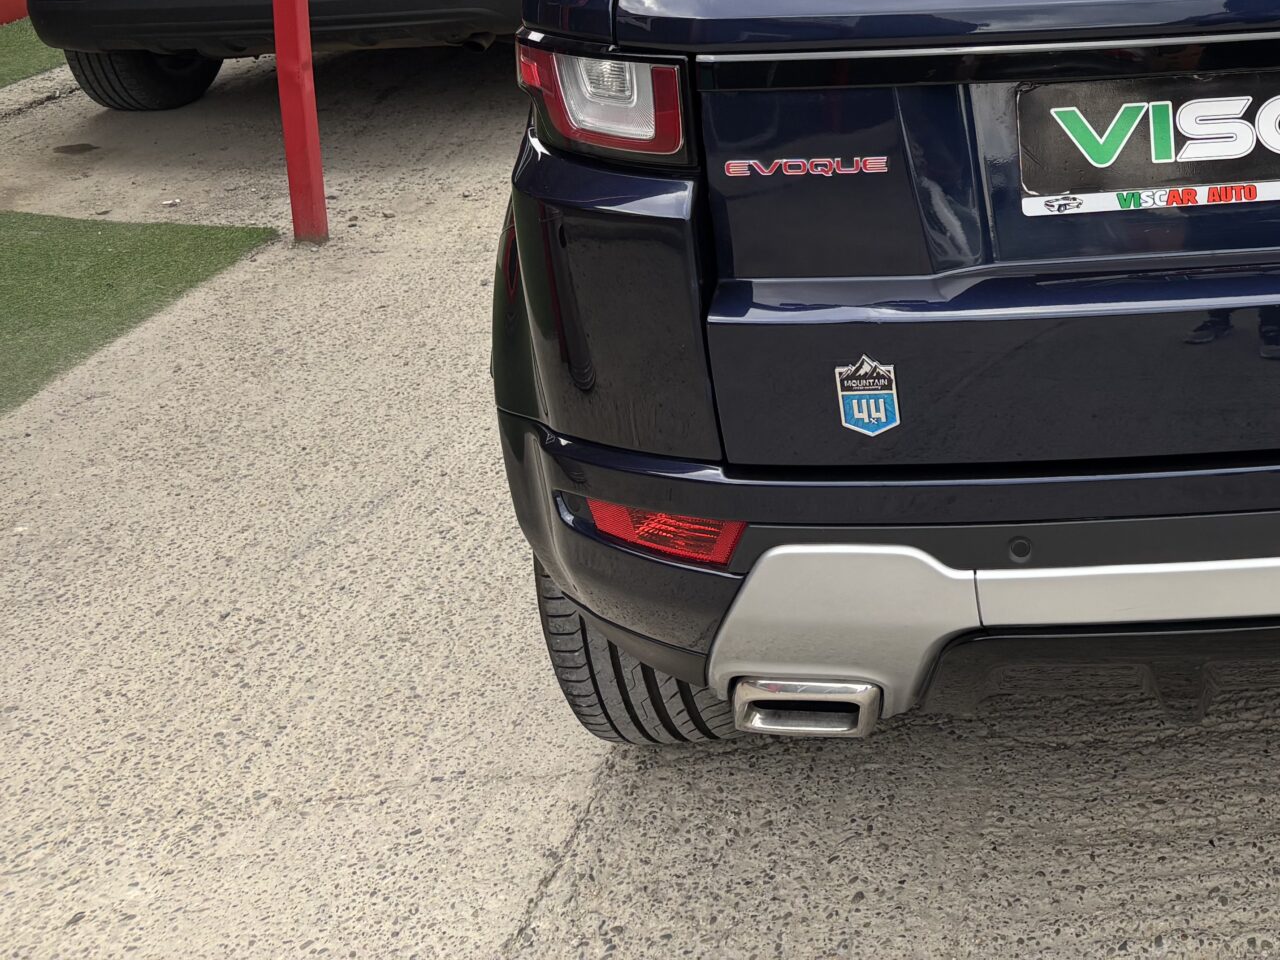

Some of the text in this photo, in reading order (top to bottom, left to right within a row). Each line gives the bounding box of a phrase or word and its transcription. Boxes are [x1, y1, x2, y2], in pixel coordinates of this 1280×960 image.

[725, 156, 888, 176] EVOQUE
[1116, 188, 1198, 209] VISCAR
[1207, 184, 1257, 203] AUTO
[844, 379, 888, 387] MOUNTAIN
